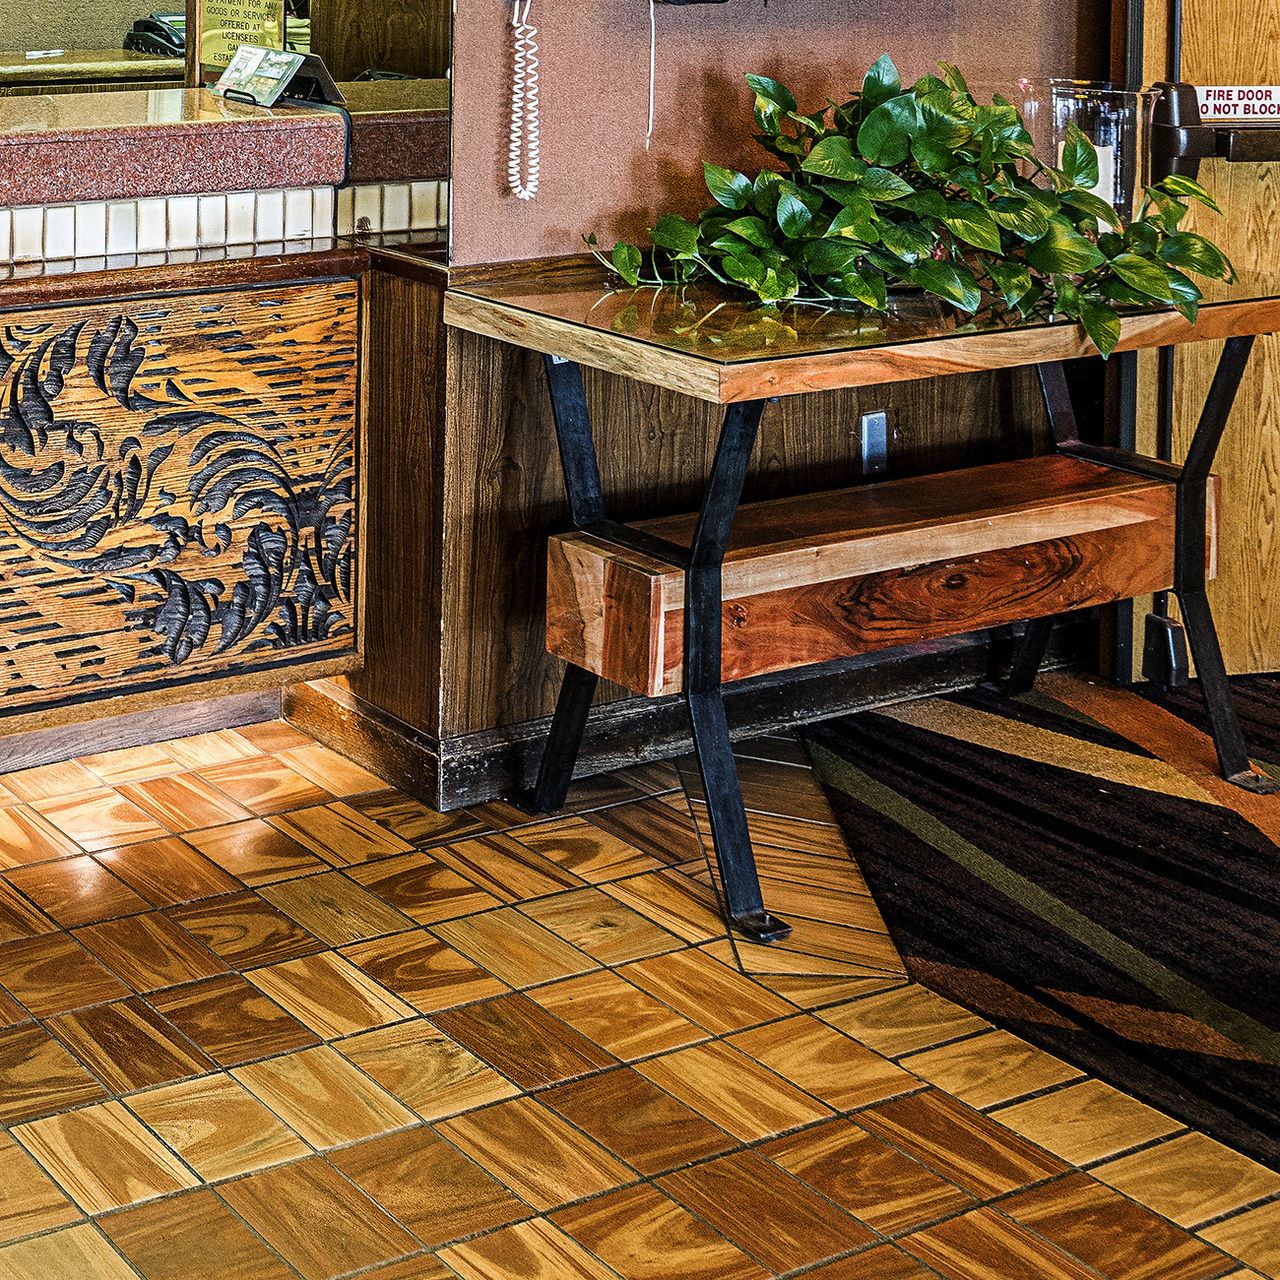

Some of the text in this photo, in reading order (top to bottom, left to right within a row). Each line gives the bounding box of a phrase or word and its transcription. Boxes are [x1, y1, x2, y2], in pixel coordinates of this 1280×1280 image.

[248, 0, 262, 9] FOR
[264, 1, 278, 10] ANY
[206, 6, 277, 22] GOODS OR SERVICES
[220, 19, 261, 32] OFFERED AT
[221, 31, 259, 43] LICENSEES
[1206, 90, 1272, 100] FIRE DOOR
[1213, 103, 1239, 115] NOT
